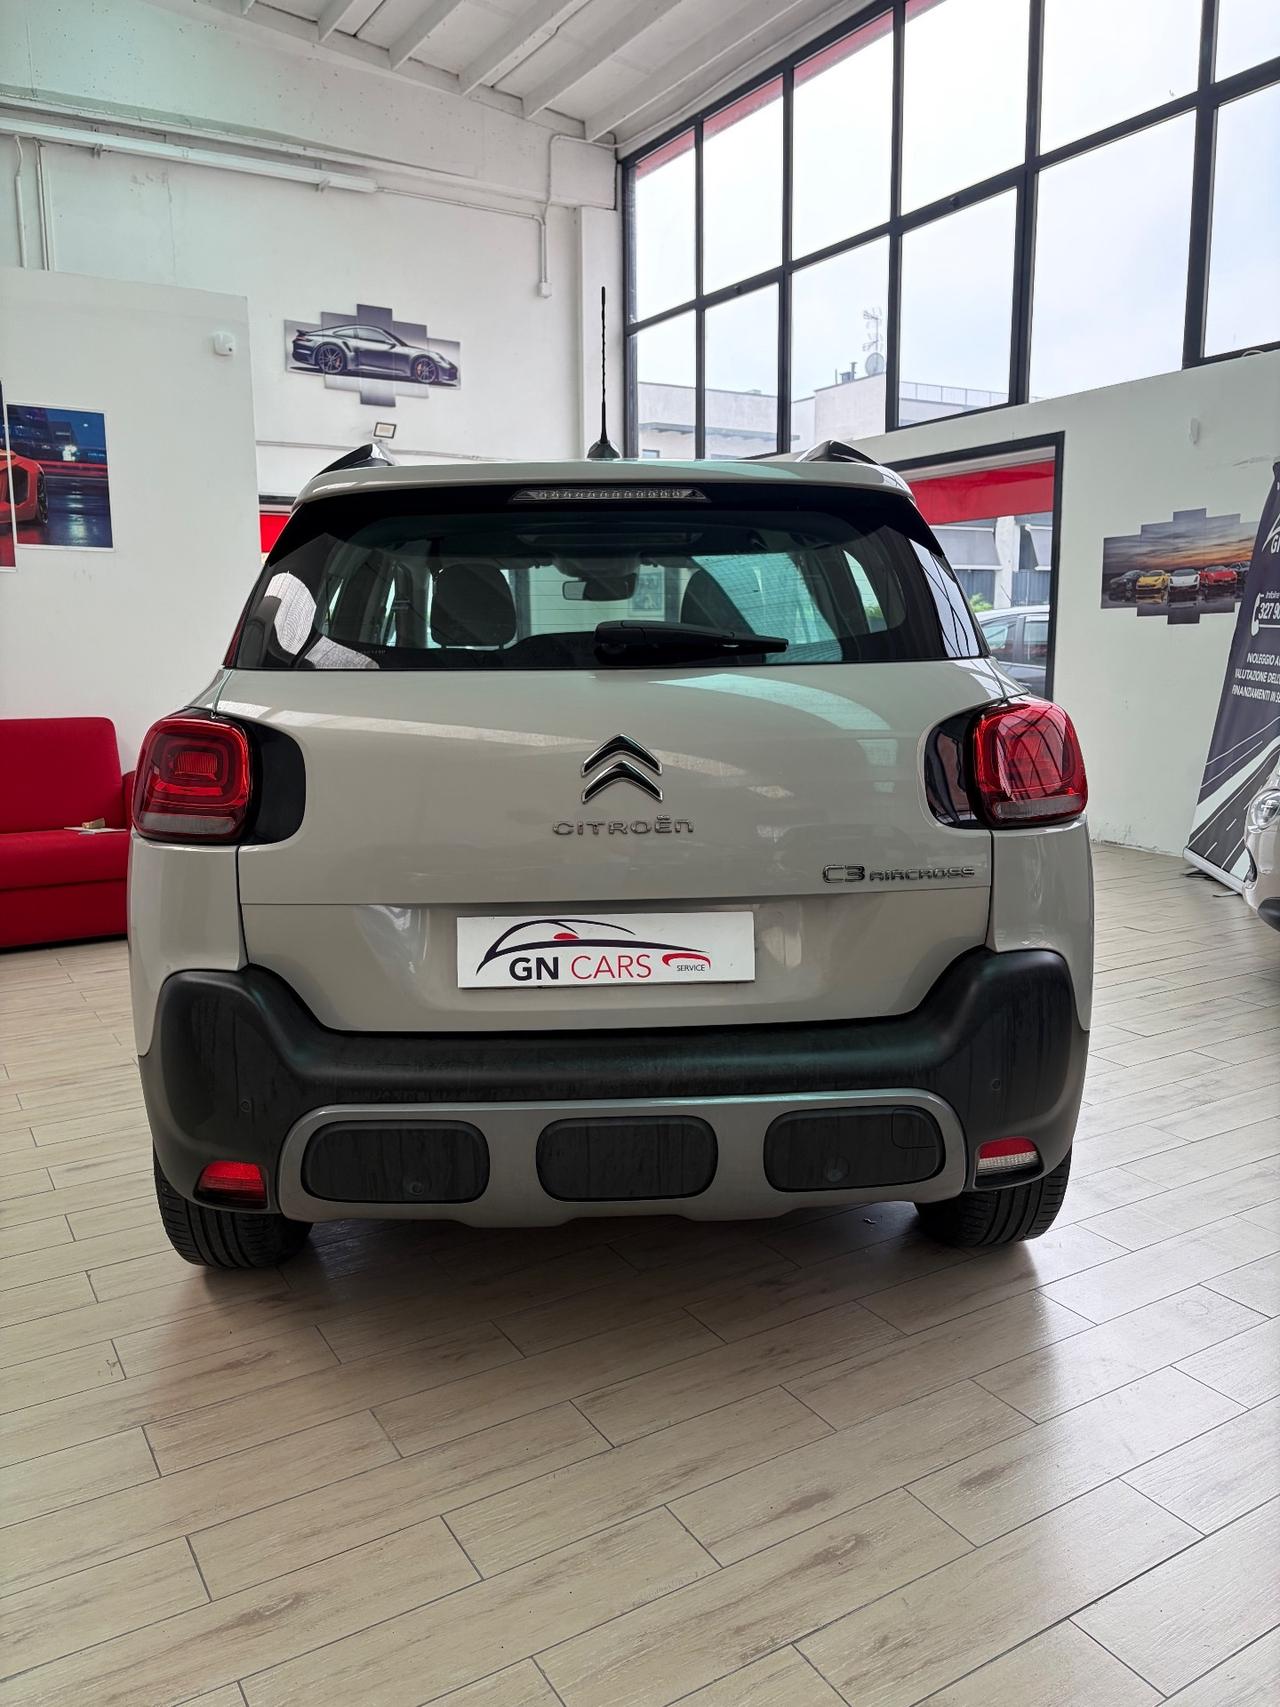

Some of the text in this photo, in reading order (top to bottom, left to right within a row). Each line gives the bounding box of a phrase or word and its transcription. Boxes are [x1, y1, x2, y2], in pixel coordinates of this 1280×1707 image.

[1247, 652, 1275, 666] NOLEGGIO
[1235, 668, 1267, 682] VALUTAZIONE
[1231, 684, 1270, 700] FINANZIAMENTI
[822, 864, 976, 883] C3 AIRCROSS
[509, 954, 652, 981] GN CARS
[676, 964, 706, 972] SERVICE
